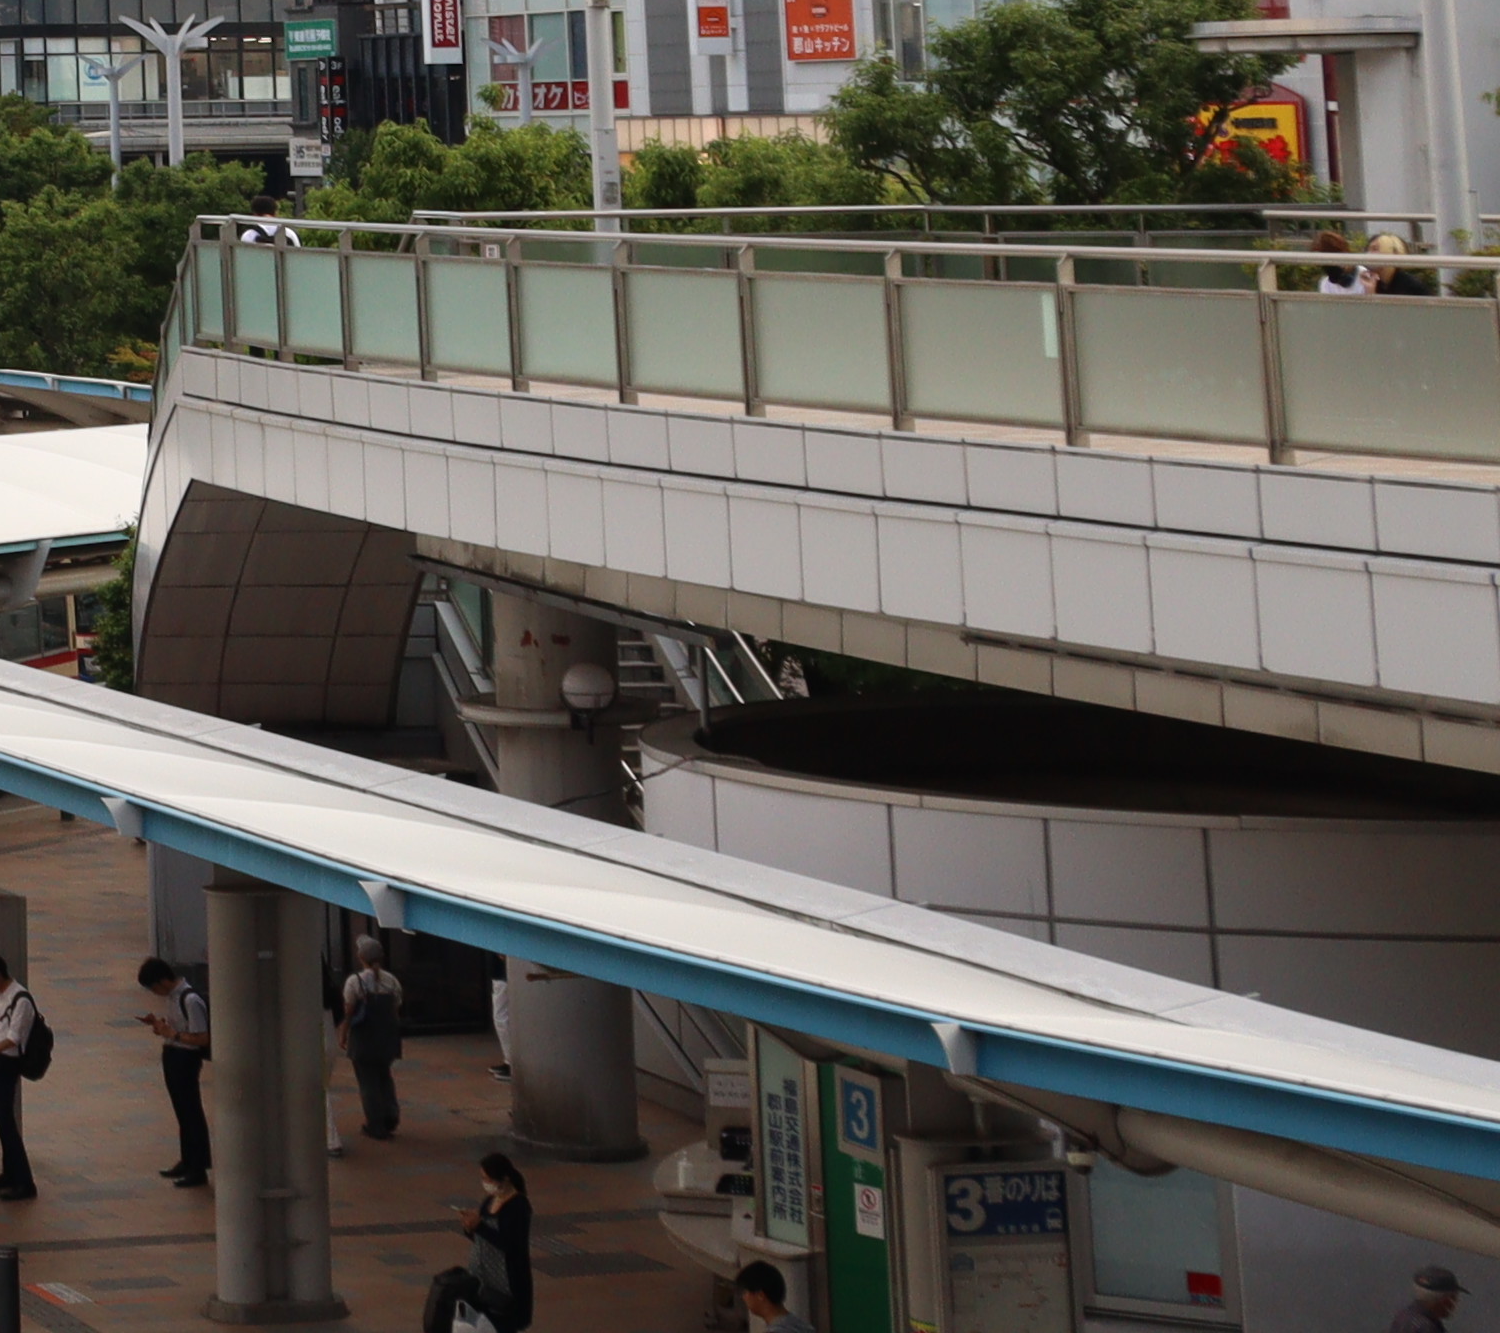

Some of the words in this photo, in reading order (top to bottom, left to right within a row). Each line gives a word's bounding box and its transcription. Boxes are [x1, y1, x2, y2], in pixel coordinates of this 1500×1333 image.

[793, 36, 850, 54] 郡山キッチン
[501, 85, 564, 111] カオケ
[851, 1089, 870, 1140] 3
[766, 1092, 788, 1221] 郡山駅前案内所
[783, 1078, 804, 1225] 福島交通株式会社
